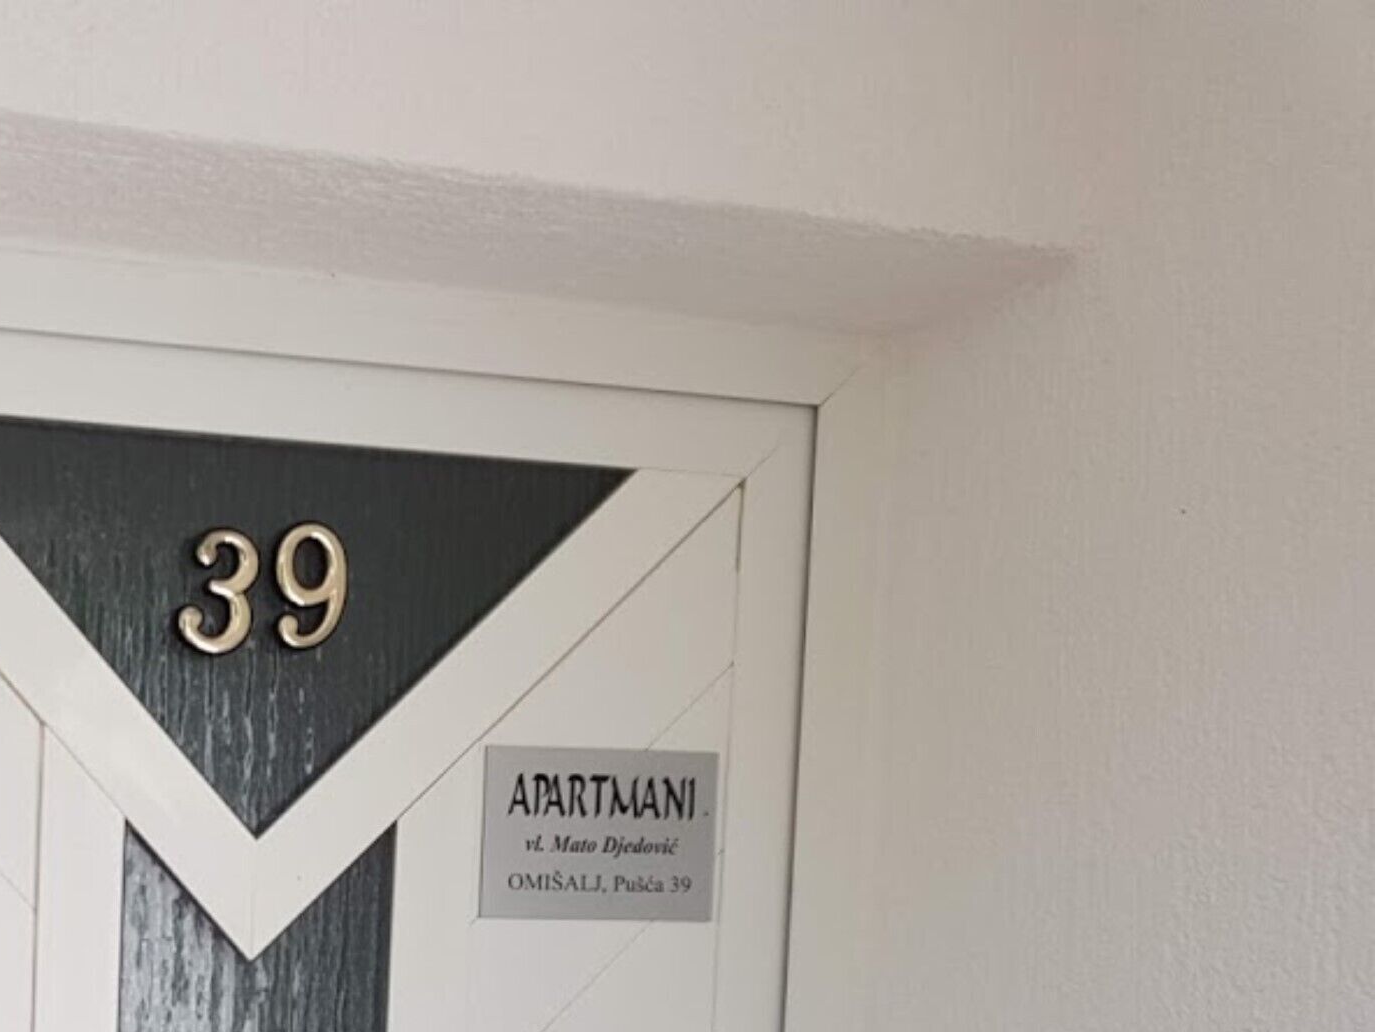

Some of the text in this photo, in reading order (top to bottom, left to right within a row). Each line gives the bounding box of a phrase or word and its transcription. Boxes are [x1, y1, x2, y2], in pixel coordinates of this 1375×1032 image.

[178, 522, 347, 654] 39
[508, 773, 696, 820] APARTMANI
[550, 834, 597, 854] Mato
[508, 870, 693, 893] OMIŠALJ, Pušća 39
